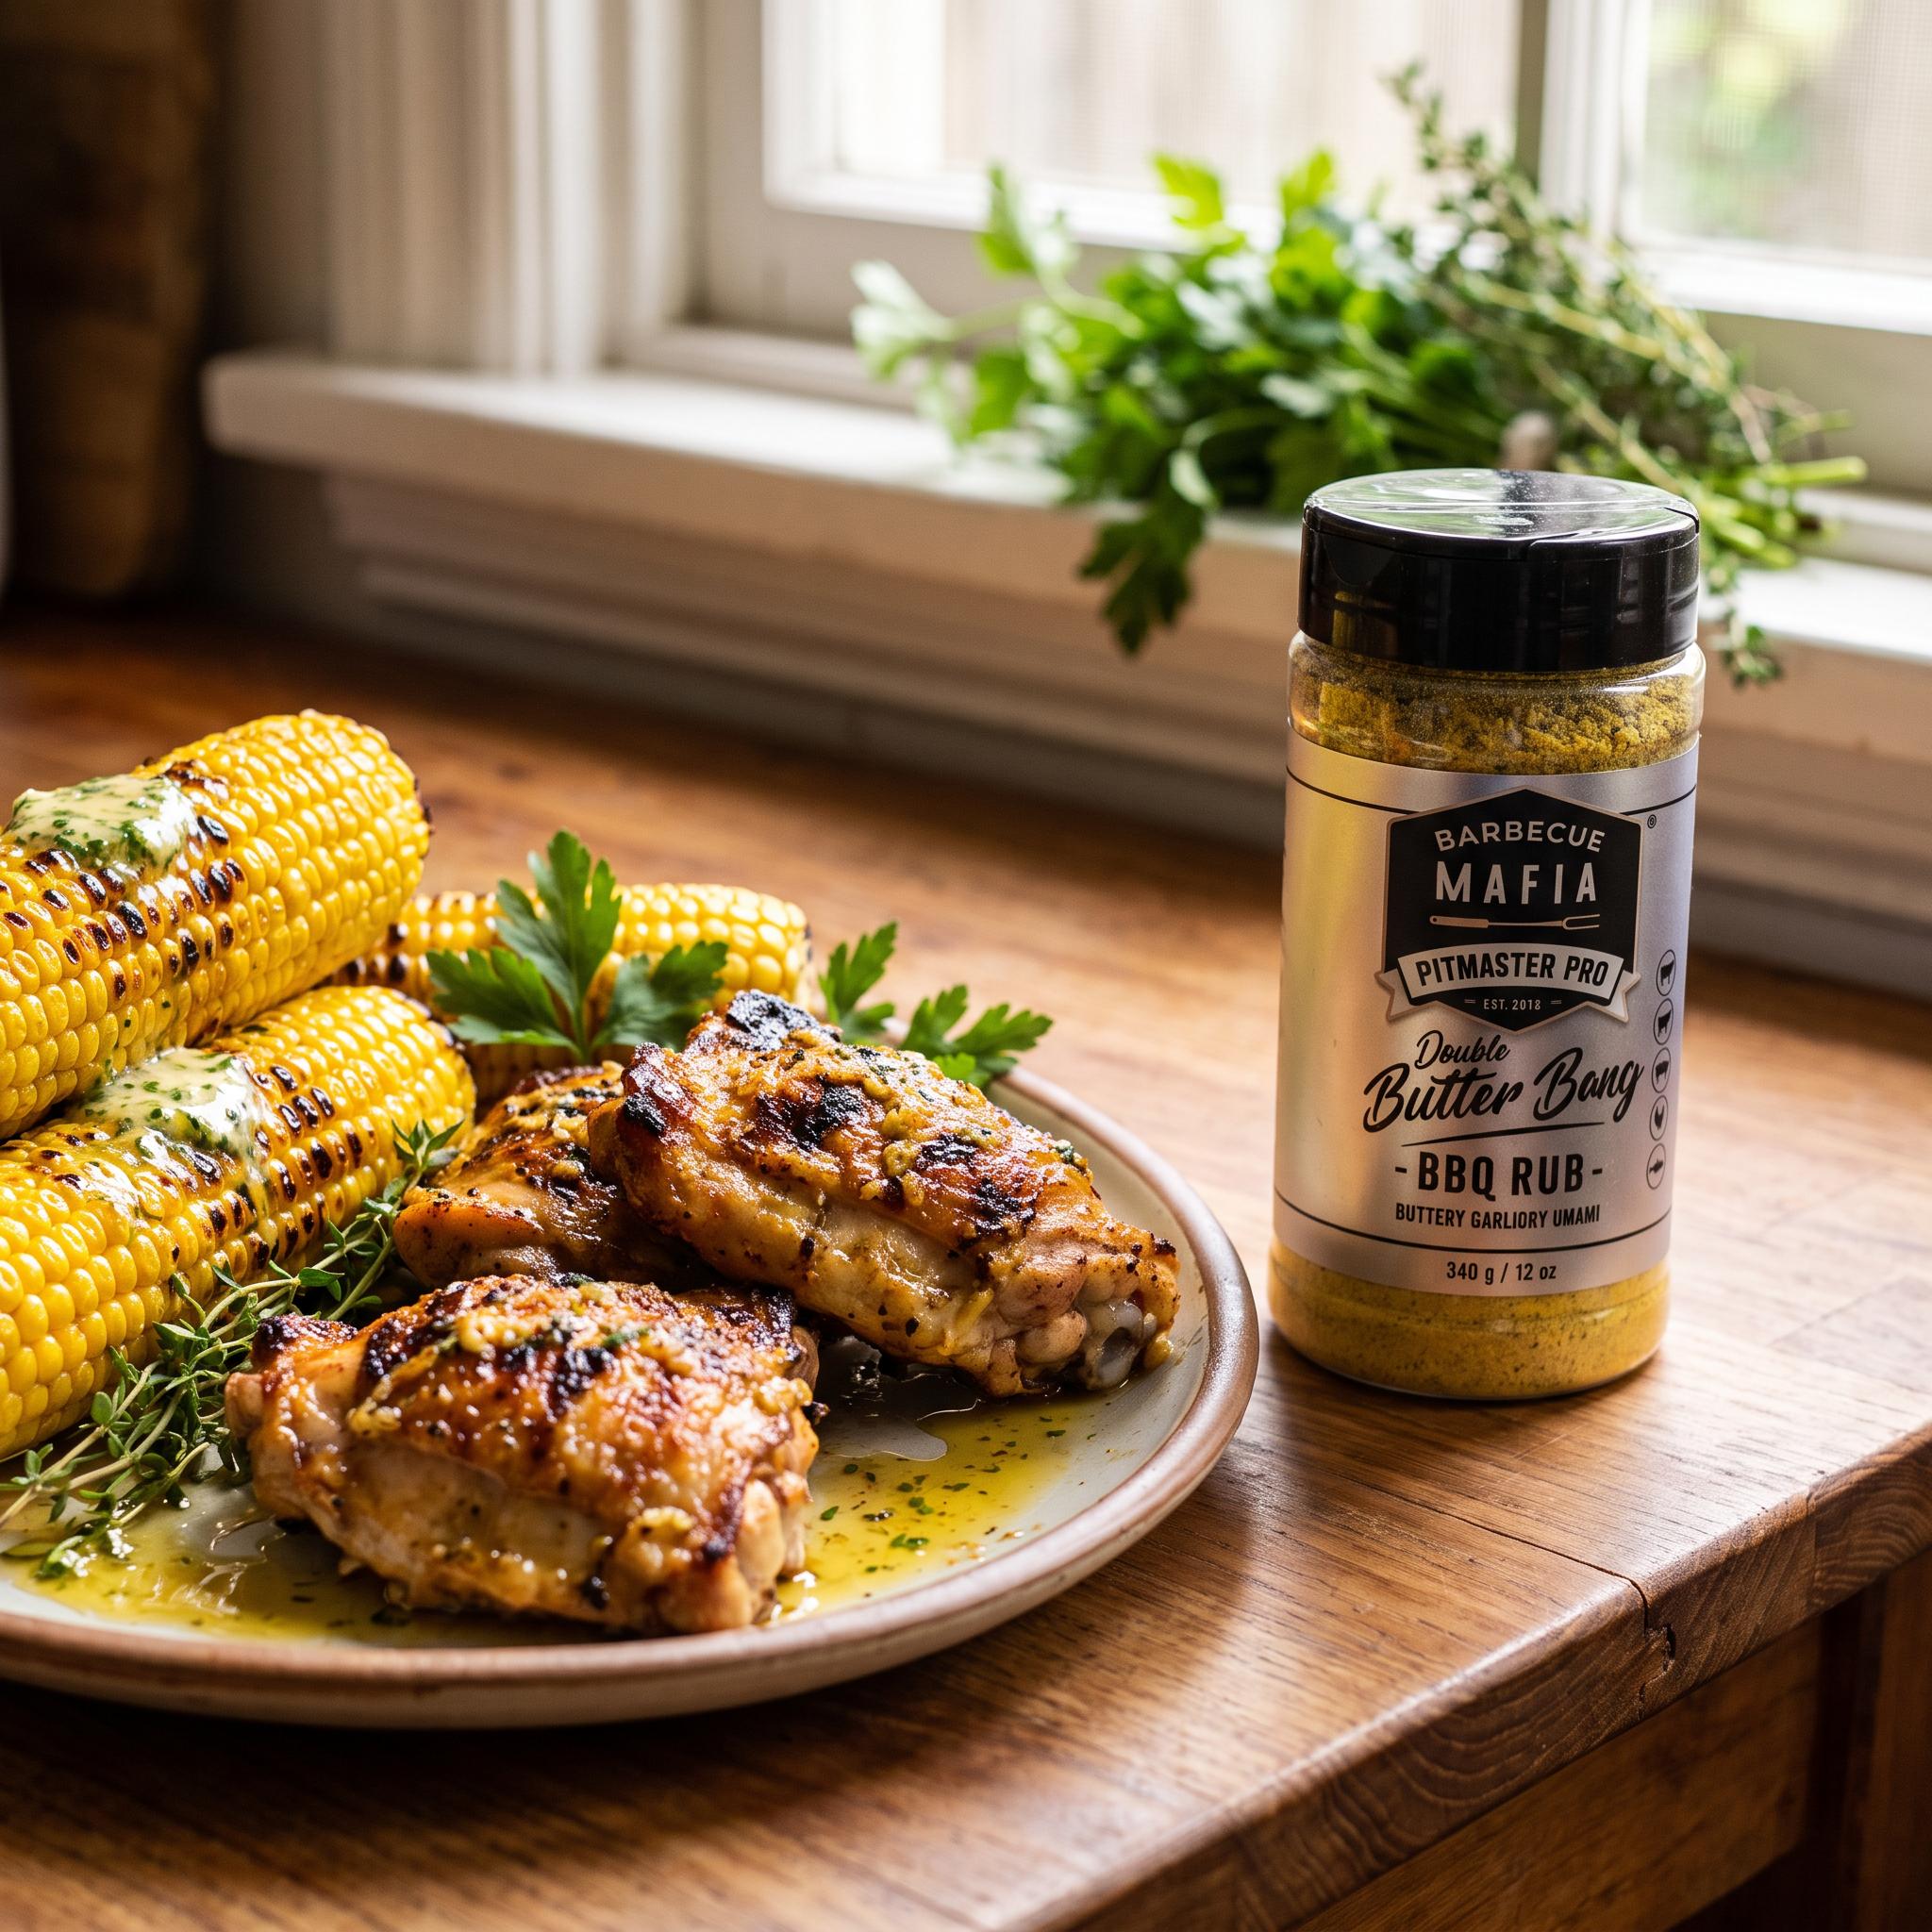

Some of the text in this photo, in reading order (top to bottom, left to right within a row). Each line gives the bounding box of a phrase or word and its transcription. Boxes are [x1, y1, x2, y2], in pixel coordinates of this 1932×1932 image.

[1434, 821, 1606, 853] BARBECUE
[1435, 860, 1597, 905] MAFIA
[1415, 952, 1609, 987] PITMASTER PRO
[1483, 998, 1541, 1011] EST. 2018
[1414, 1029, 1510, 1070] Double
[1362, 1047, 1644, 1133] Butter Bang
[1418, 1151, 1584, 1202] BBQ RUB
[1395, 1202, 1465, 1228] BUTTERY
[1553, 1204, 1601, 1227] UMAMI
[1446, 1261, 1557, 1286] 340 g / 12 oz
